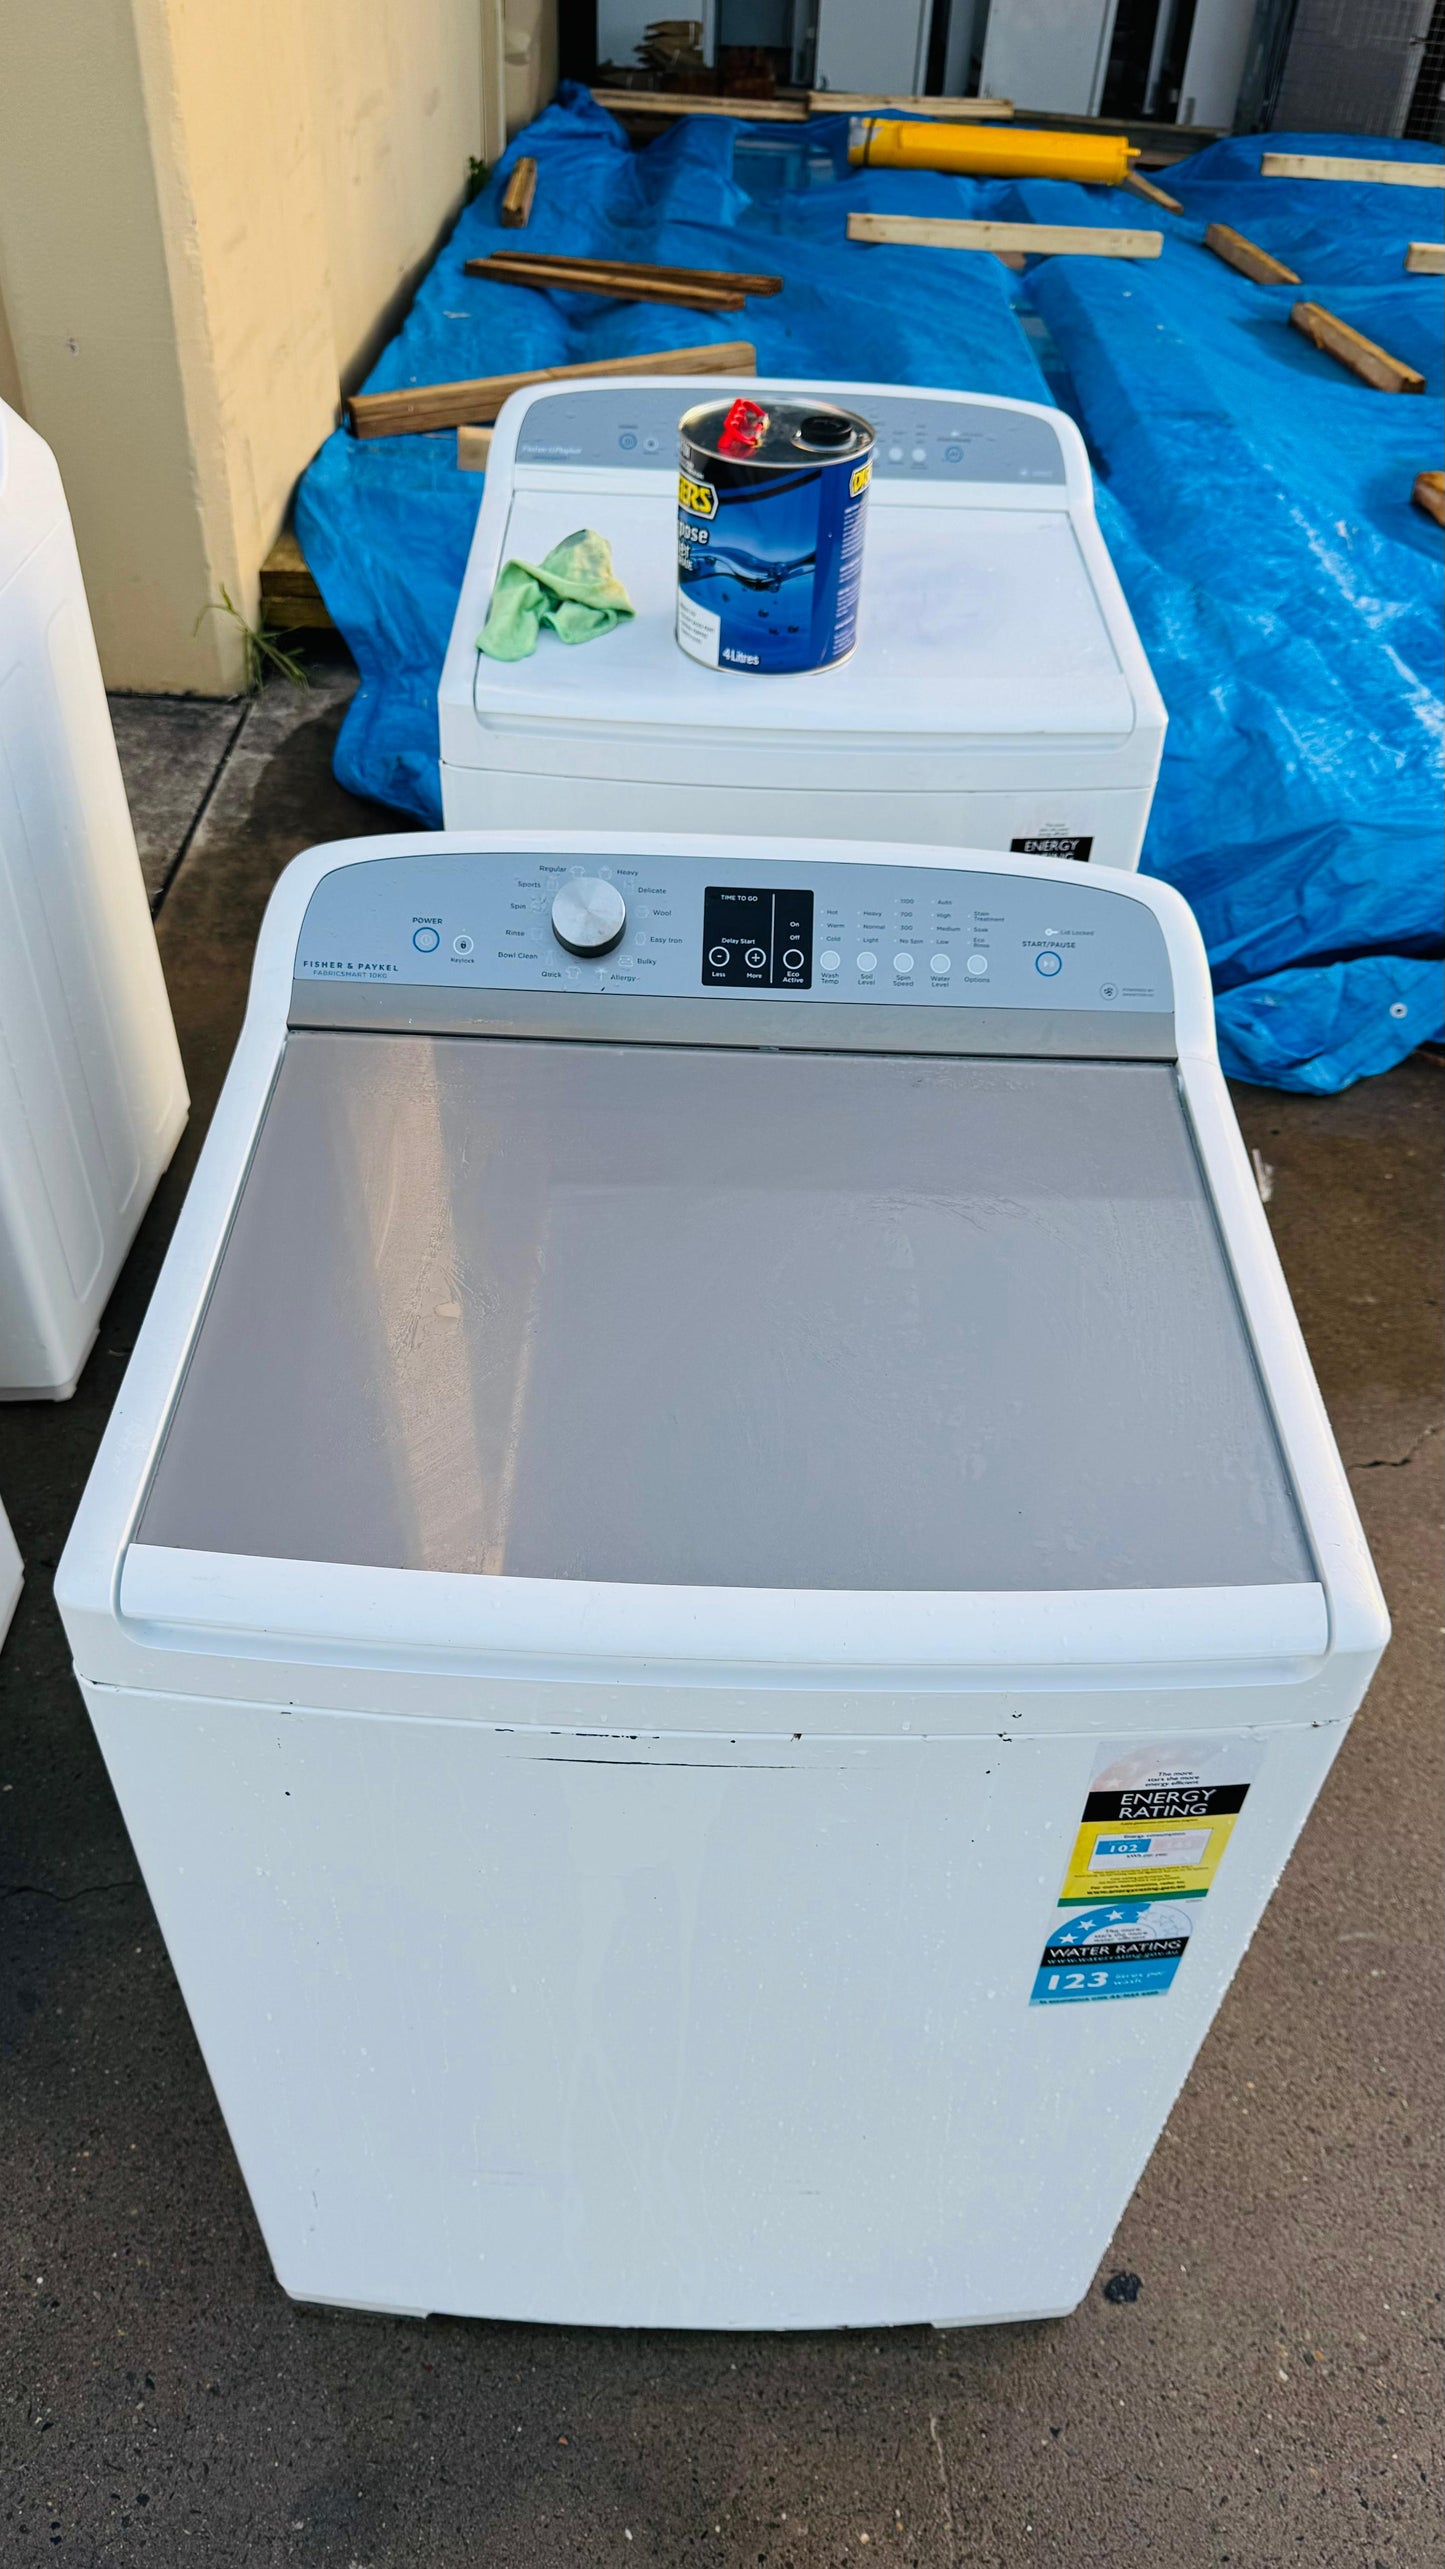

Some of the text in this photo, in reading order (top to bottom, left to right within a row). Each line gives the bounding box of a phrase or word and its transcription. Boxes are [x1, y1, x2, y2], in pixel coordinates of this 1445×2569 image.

[679, 476, 712, 513] ERS
[1023, 840, 1080, 852] ENERGY
[539, 865, 567, 874] Regular
[616, 869, 639, 877] Heavy
[517, 880, 541, 889] Sports
[637, 887, 667, 895] Delicate
[510, 903, 527, 911] Spin
[652, 909, 672, 917] Wool
[412, 917, 443, 925] POWER
[650, 936, 666, 944] Easy
[1022, 940, 1076, 949] START/PAUSE
[517, 952, 538, 960] Clean
[303, 960, 343, 969] FISHER
[358, 964, 399, 972] PAYKEL
[637, 958, 657, 966] Bulky
[313, 970, 367, 978] FABRICSMART
[541, 970, 562, 978] Quick
[610, 974, 636, 983] Allergy
[782, 976, 804, 984] Active
[964, 976, 990, 984] Options
[1120, 1789, 1217, 1805] ENERGY
[1119, 1804, 1208, 1818] RATING
[1109, 1844, 1138, 1853] 102
[1049, 1940, 1182, 1958] WATER RATING
[1048, 1972, 1109, 1991] 123
